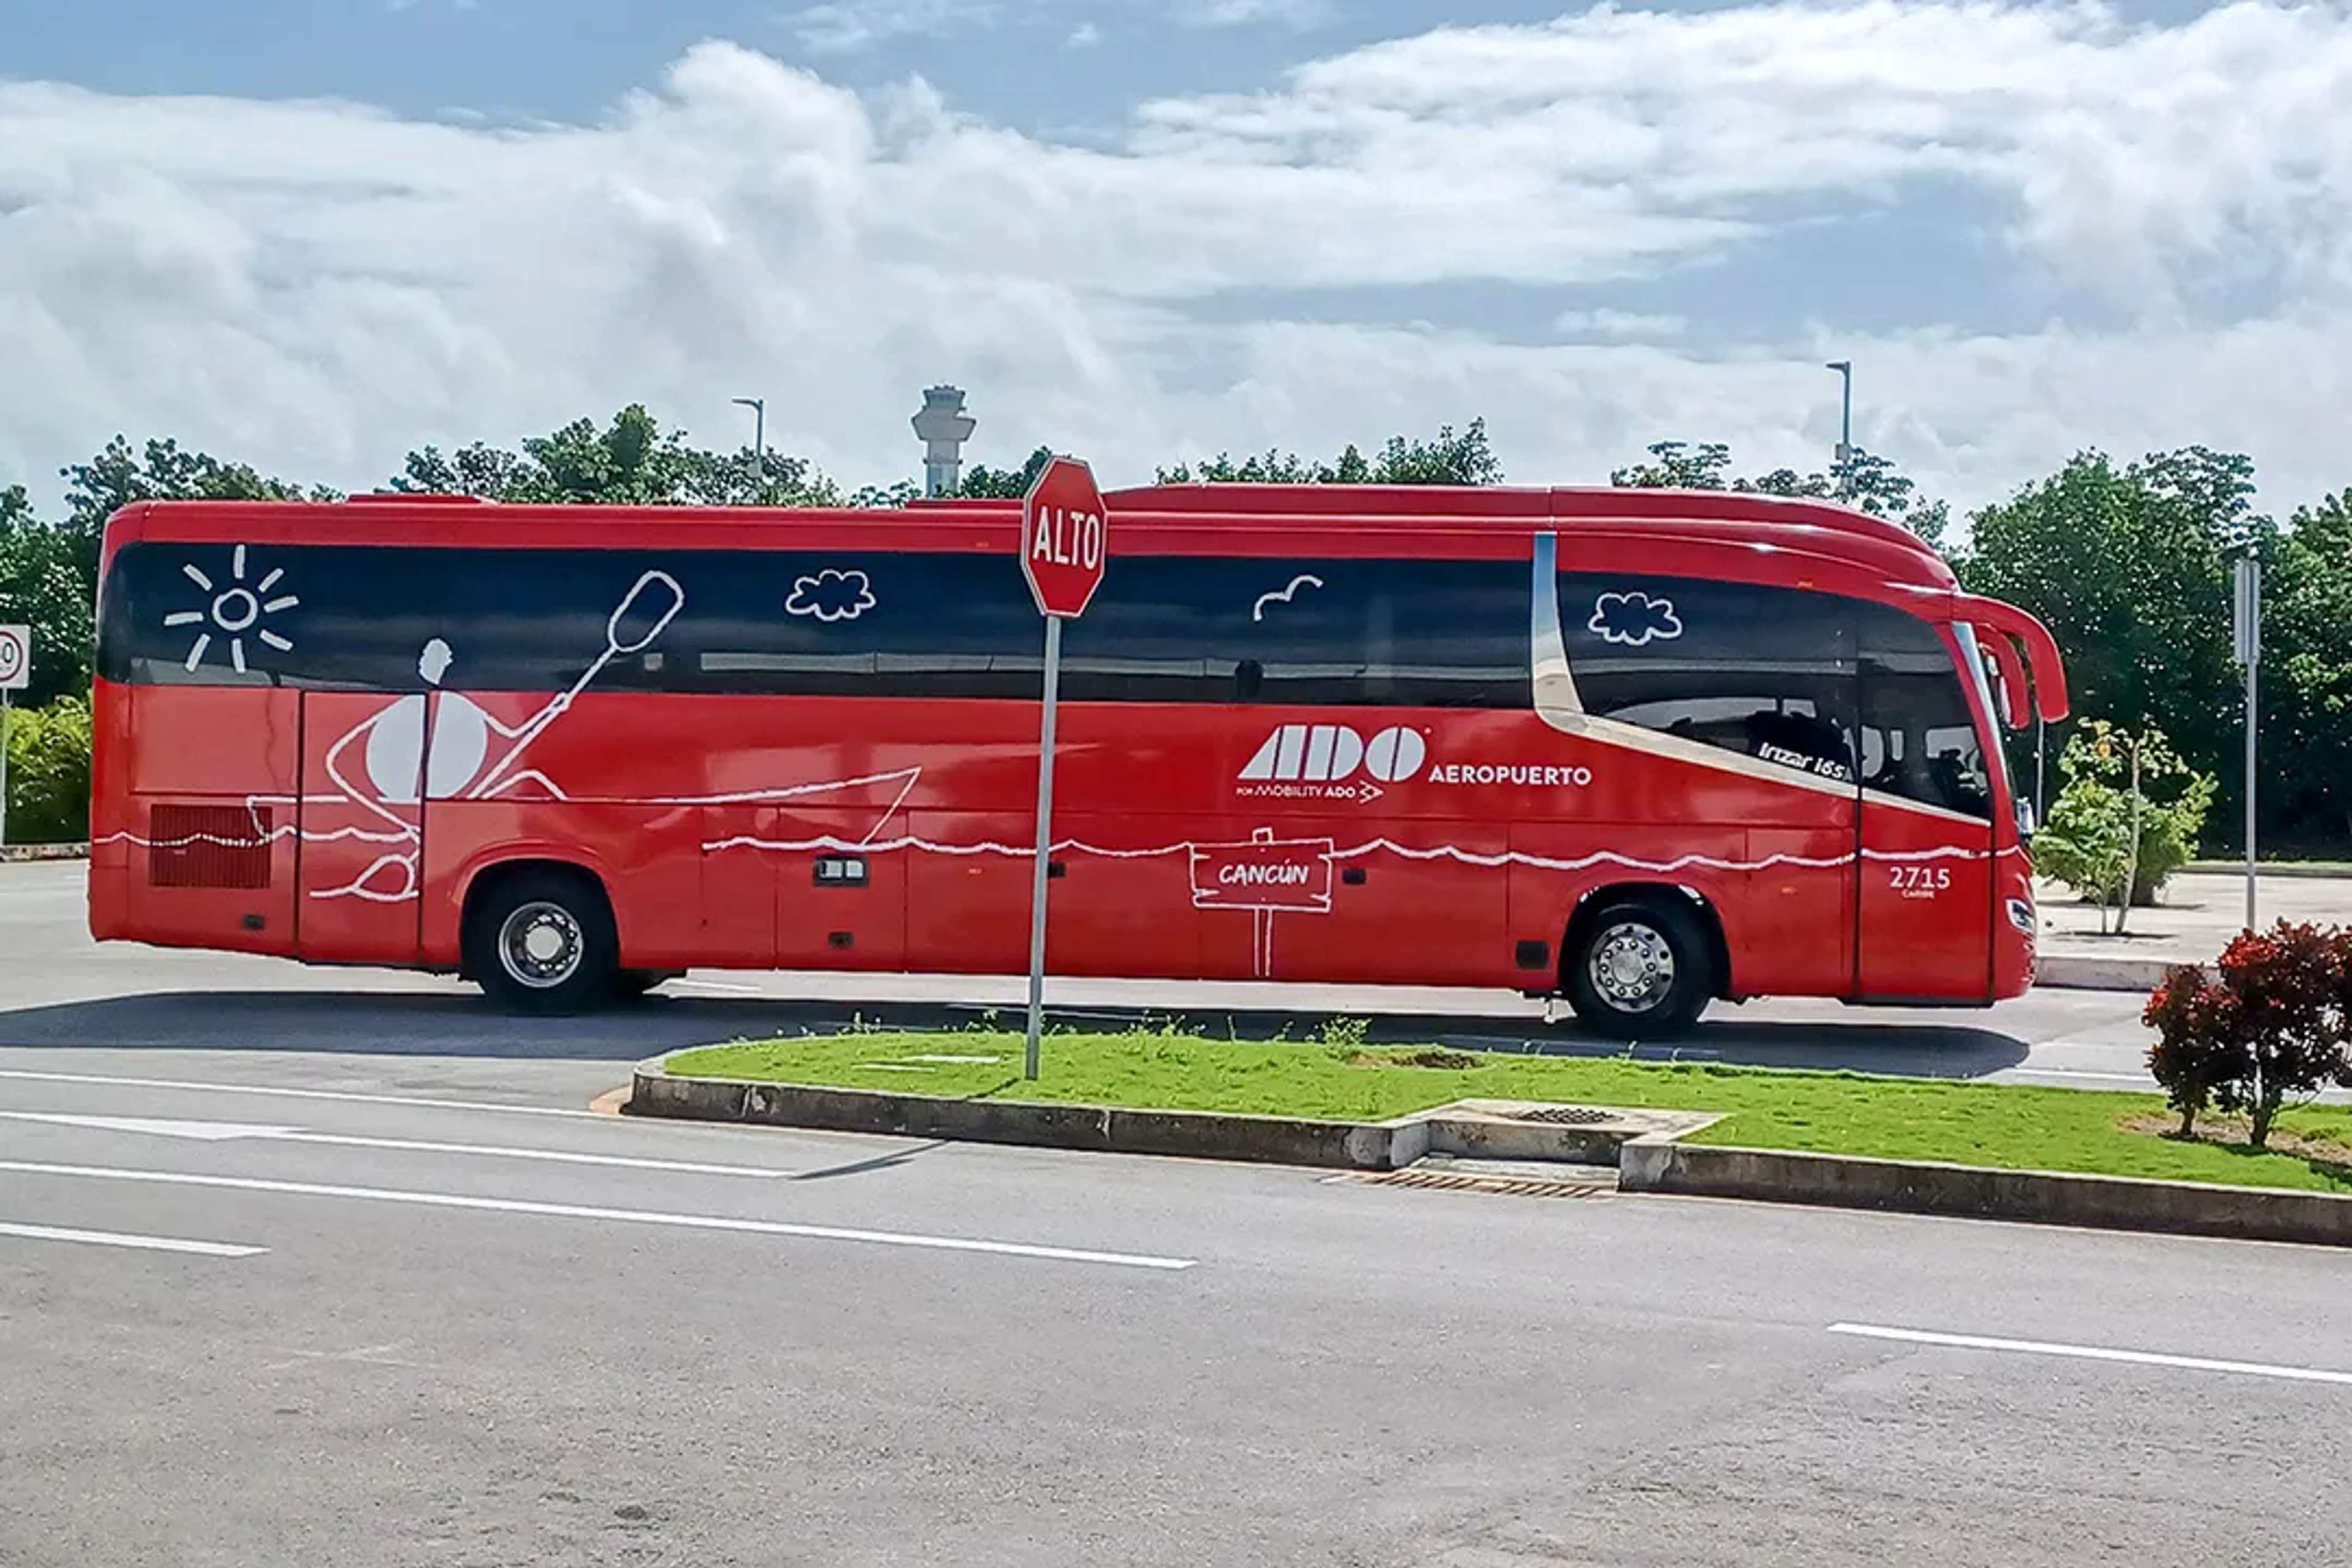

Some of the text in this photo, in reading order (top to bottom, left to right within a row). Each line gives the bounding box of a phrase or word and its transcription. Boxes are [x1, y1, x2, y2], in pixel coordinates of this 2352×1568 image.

[1032, 505, 1100, 570] ALTO
[0, 642, 13, 663] 0
[1237, 725, 1426, 782] ADO
[1428, 764, 1592, 785] AEROPUERTO
[1255, 785, 1322, 797] MOBILITY
[1324, 786, 1355, 798] ADO
[1219, 858, 1309, 885] CANCÚN
[1890, 867, 1950, 889] 2715
